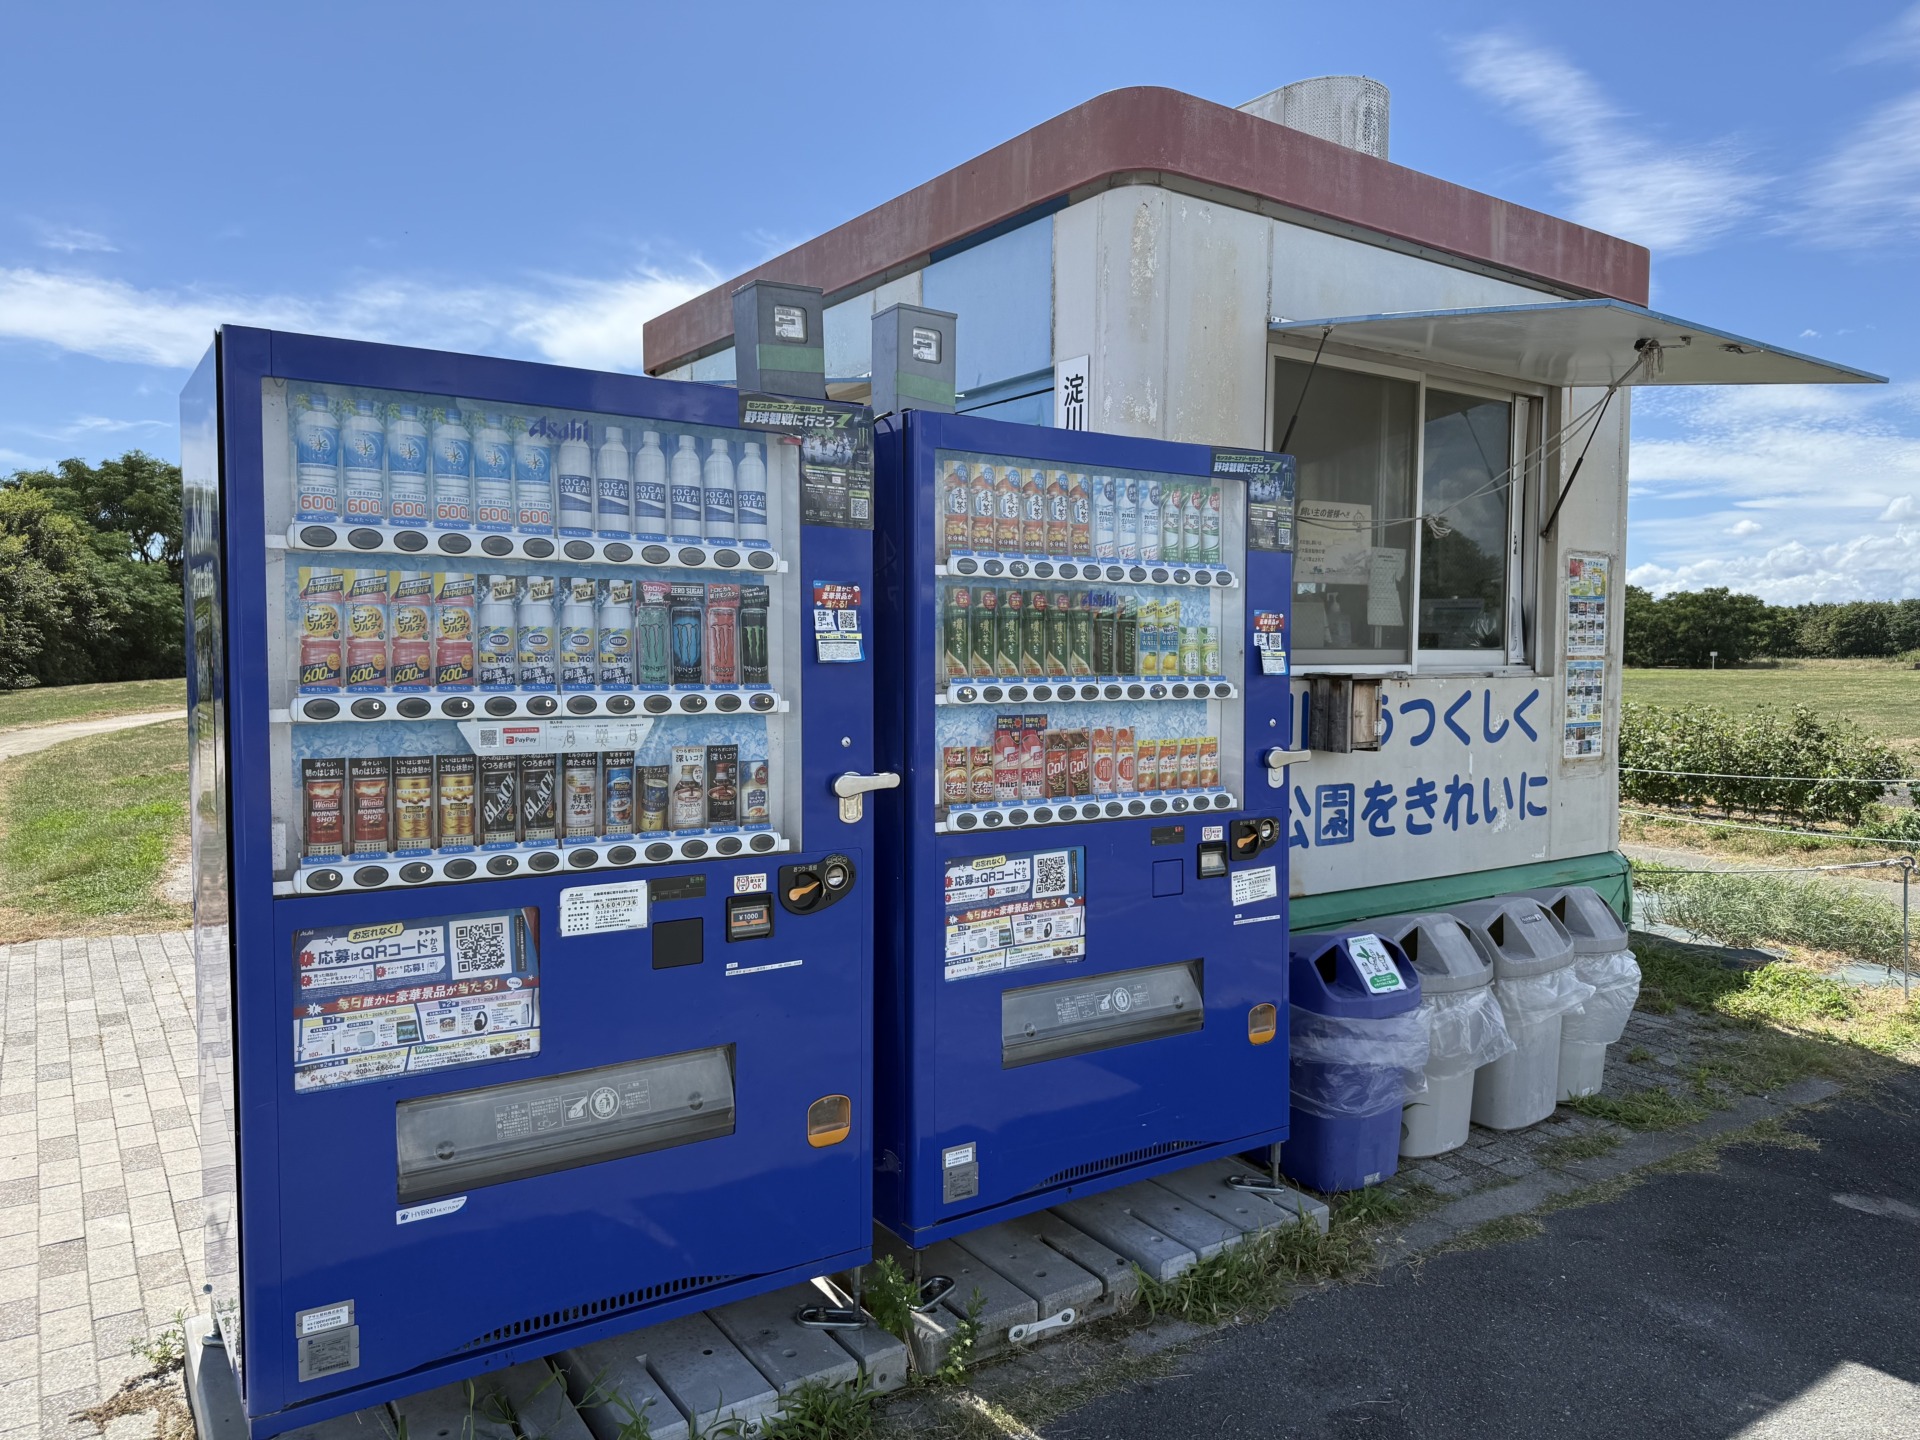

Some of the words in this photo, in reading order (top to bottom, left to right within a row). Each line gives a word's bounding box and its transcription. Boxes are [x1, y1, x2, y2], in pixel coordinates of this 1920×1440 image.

[1064, 374, 1084, 431] 淀川
[744, 410, 835, 427] 野球観戦に行こう
[529, 416, 589, 442] Asahi
[1214, 462, 1270, 474] 野球観戦に行こう
[307, 612, 336, 622] ピングレ
[353, 613, 380, 624] ピングレ
[398, 615, 425, 625] ピングレ
[443, 616, 469, 625] ピングレ
[309, 621, 337, 631] ソルティ
[354, 622, 382, 632] ソルティ
[400, 624, 426, 633] ソルティ
[444, 625, 470, 633] ソルティ
[515, 736, 537, 744] PayPay
[676, 754, 704, 762] 深いコク
[305, 768, 344, 776] 朝のはじまりに
[352, 768, 388, 776] 朝のはじまりに
[395, 766, 432, 774] 上質な休憩から
[440, 764, 474, 772] 上質な休憩から
[484, 772, 515, 824] BLACK
[524, 770, 554, 821] BLACK
[573, 794, 592, 804] 特製
[738, 912, 758, 920] ¥1000
[352, 924, 398, 940] お忘れなく!
[337, 978, 498, 1010] 毎日誰かに豪華景品が当たる!
[411, 1208, 436, 1218] HYBRID
